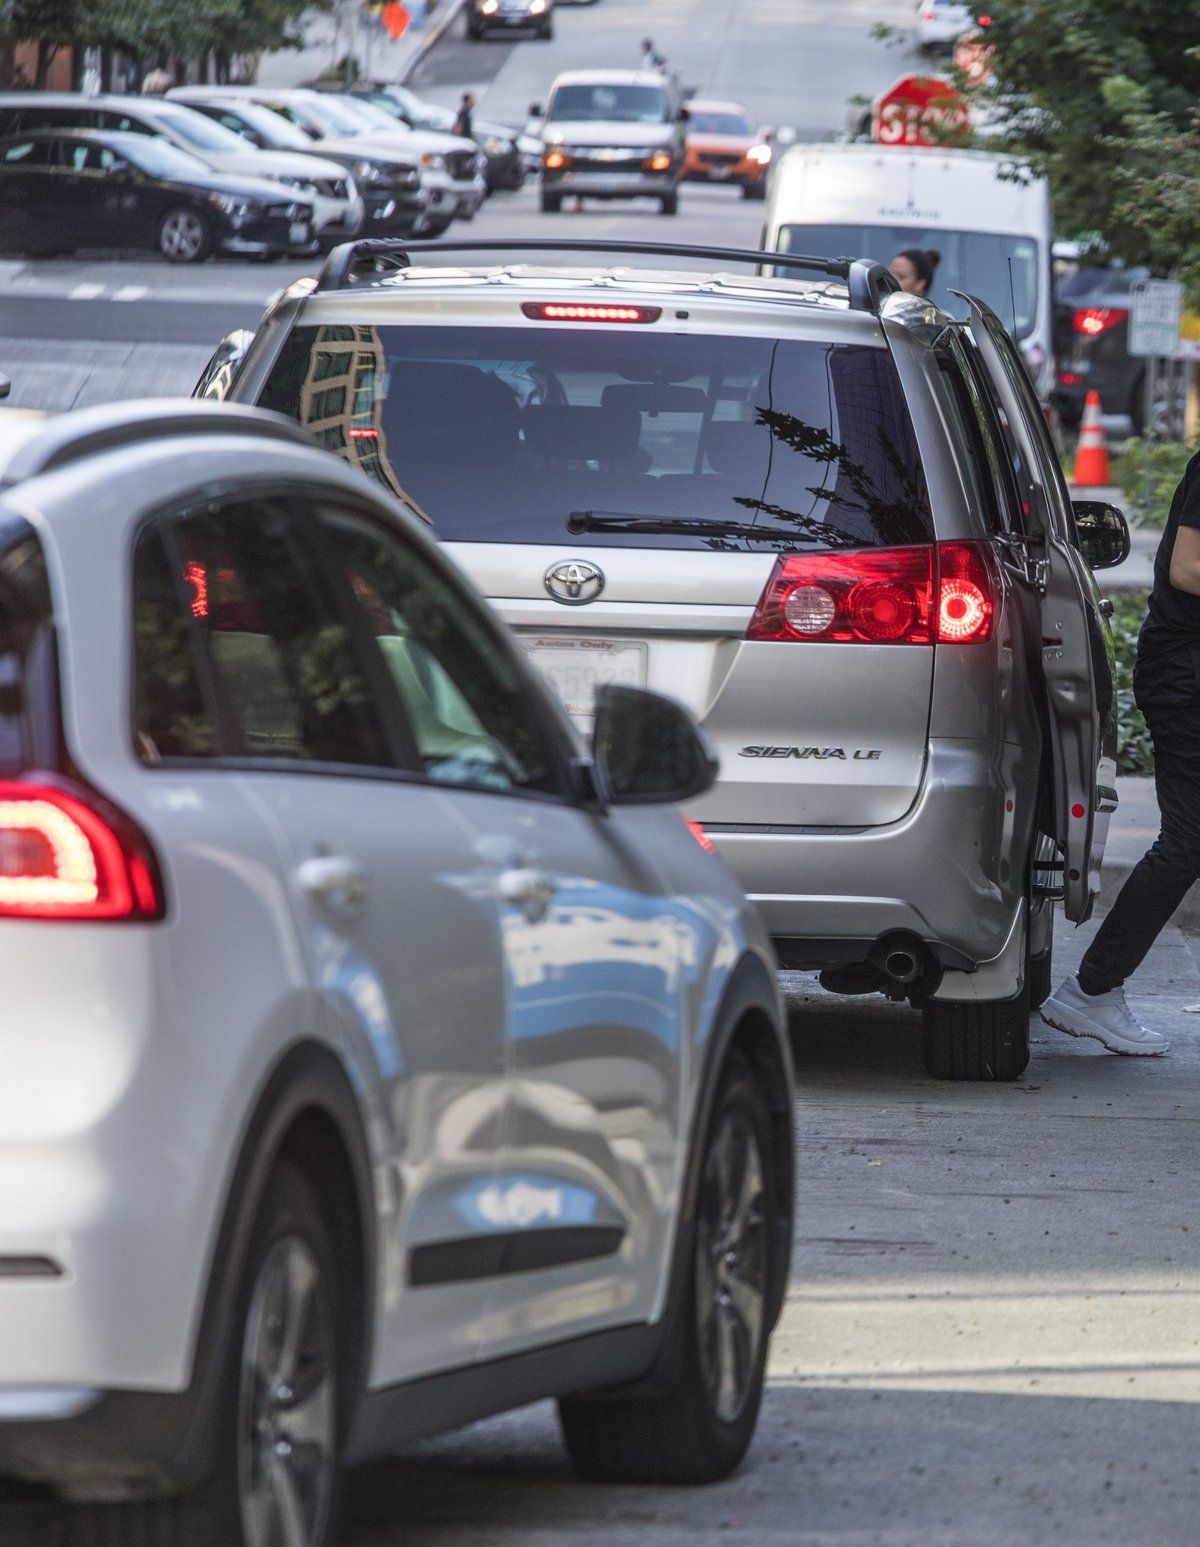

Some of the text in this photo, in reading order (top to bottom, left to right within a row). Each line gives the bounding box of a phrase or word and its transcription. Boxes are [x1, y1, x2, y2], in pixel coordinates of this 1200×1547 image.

[580, 641, 613, 650] Only
[737, 745, 882, 760] SIENNA LE
